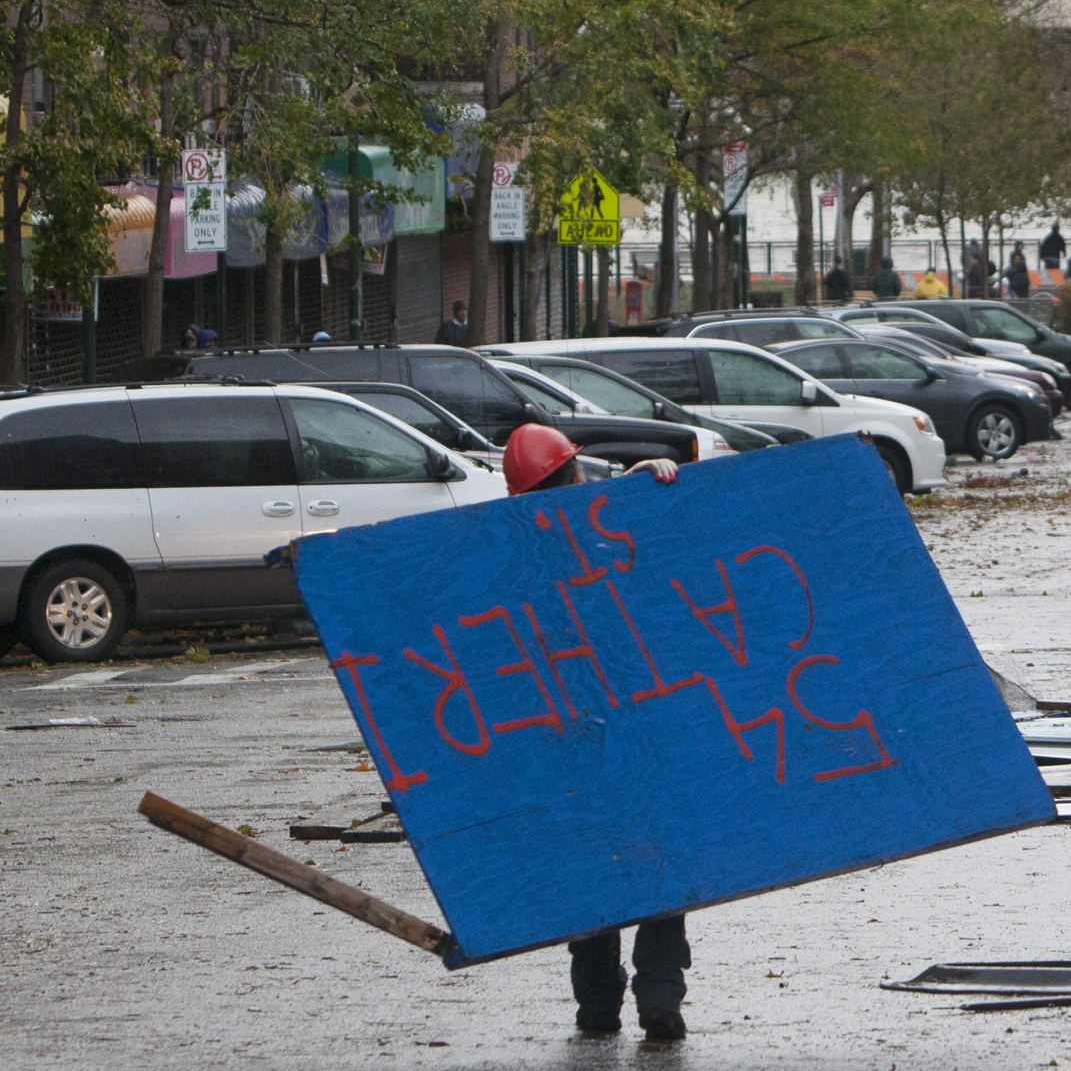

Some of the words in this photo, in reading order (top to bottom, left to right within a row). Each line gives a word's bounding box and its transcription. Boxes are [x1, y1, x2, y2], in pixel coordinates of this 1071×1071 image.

[213, 187, 221, 197] IN
[493, 191, 511, 200] BACK
[513, 191, 521, 200] IN
[496, 201, 518, 210] ANGLE
[190, 213, 221, 224] PARKING
[493, 211, 520, 220] PARKING
[497, 221, 517, 230] ONLY
[193, 227, 217, 237] ONLY
[535, 495, 637, 586] ST.
[706, 654, 899, 784] 54
